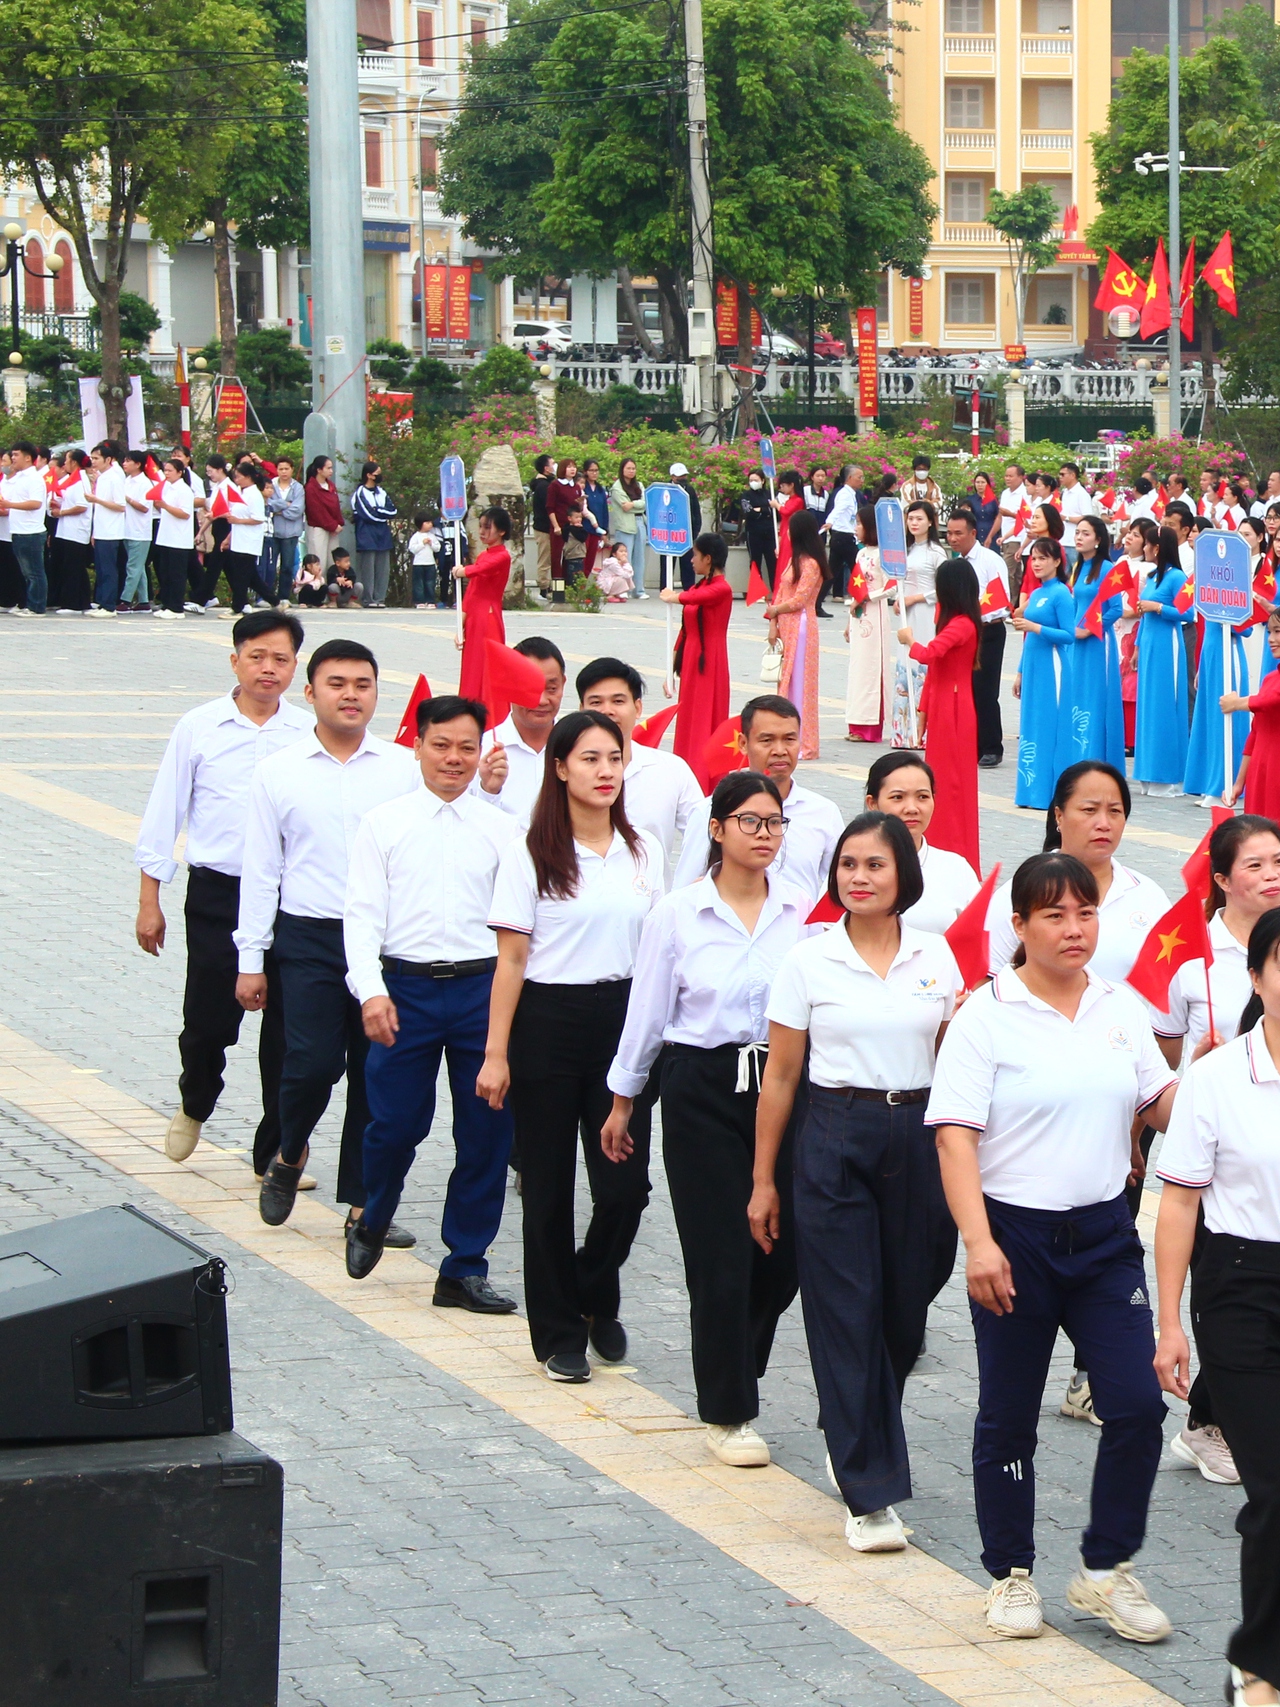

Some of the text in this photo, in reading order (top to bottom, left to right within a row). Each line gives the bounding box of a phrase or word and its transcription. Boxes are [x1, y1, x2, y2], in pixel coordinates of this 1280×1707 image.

[651, 528, 687, 544] PHỤ NỮ
[1210, 561, 1235, 583] KHỐI
[1200, 583, 1247, 608] DÂN QUÂN
